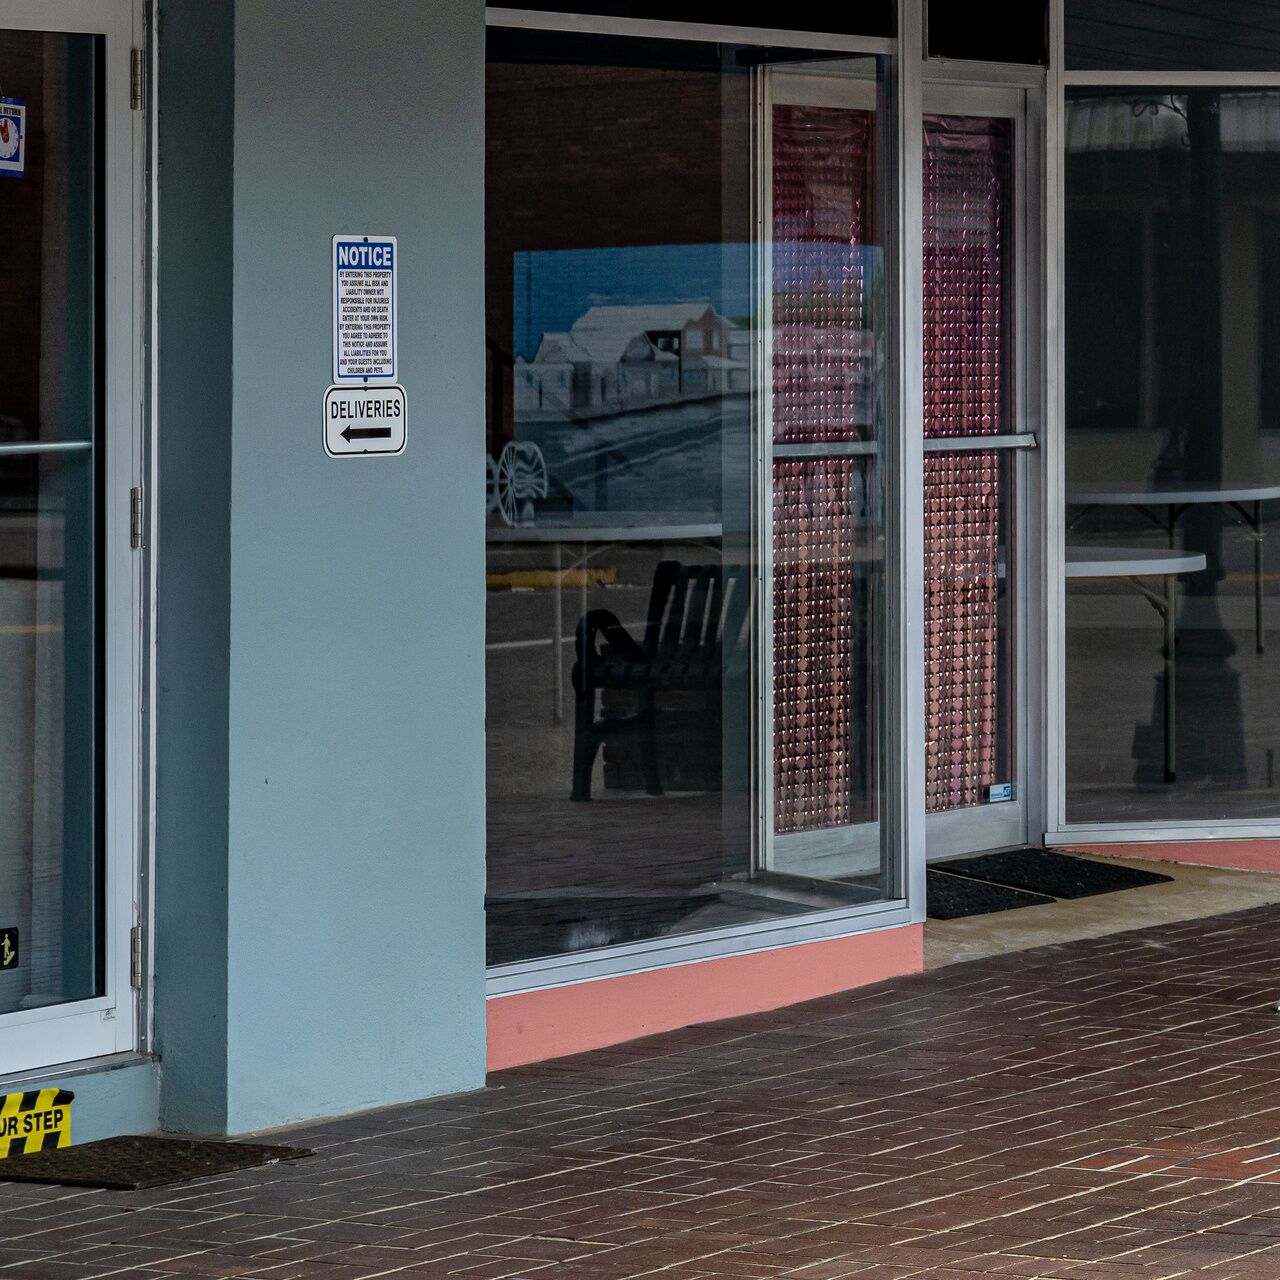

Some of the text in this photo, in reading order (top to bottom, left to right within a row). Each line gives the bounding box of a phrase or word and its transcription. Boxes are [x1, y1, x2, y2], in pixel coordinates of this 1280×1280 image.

[338, 246, 392, 266] NOTICE
[331, 400, 401, 419] DELIVERIES
[23, 1109, 63, 1133] STEP
